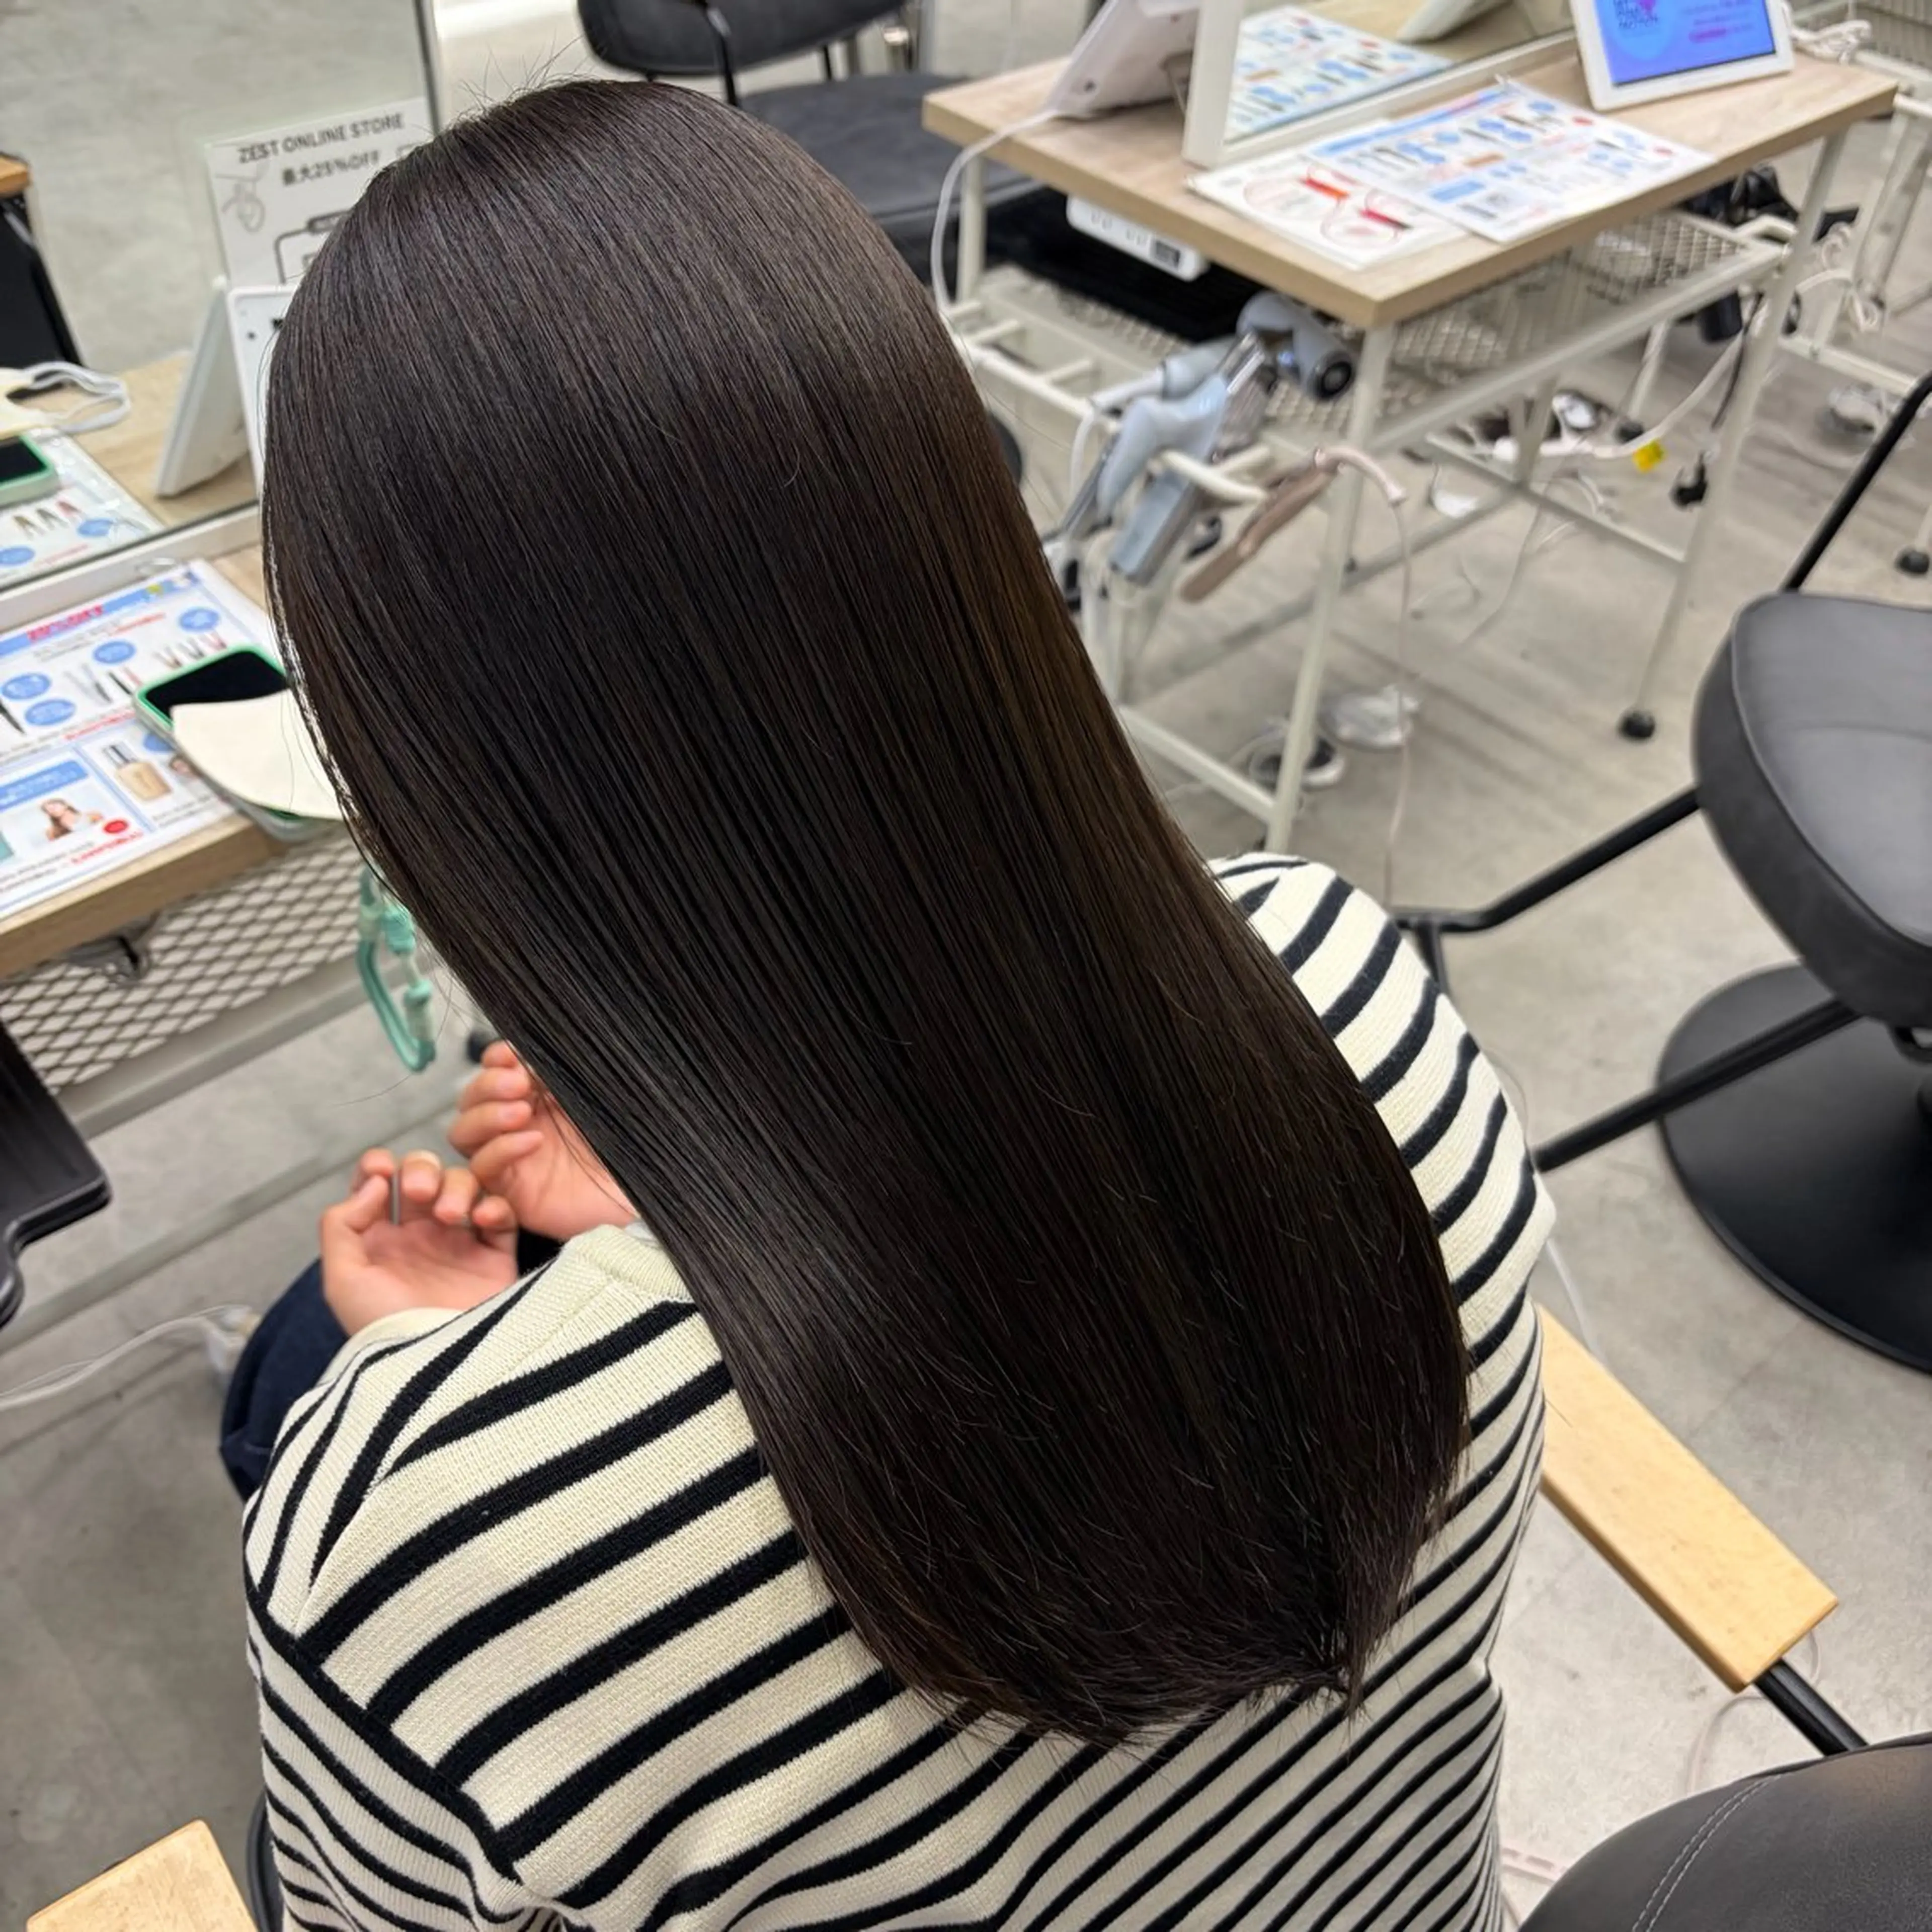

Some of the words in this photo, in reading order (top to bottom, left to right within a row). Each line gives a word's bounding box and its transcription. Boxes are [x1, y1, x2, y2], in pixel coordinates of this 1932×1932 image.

[238, 139, 278, 163] ZEST
[282, 125, 345, 152] ONLINE
[351, 113, 403, 138] STORE
